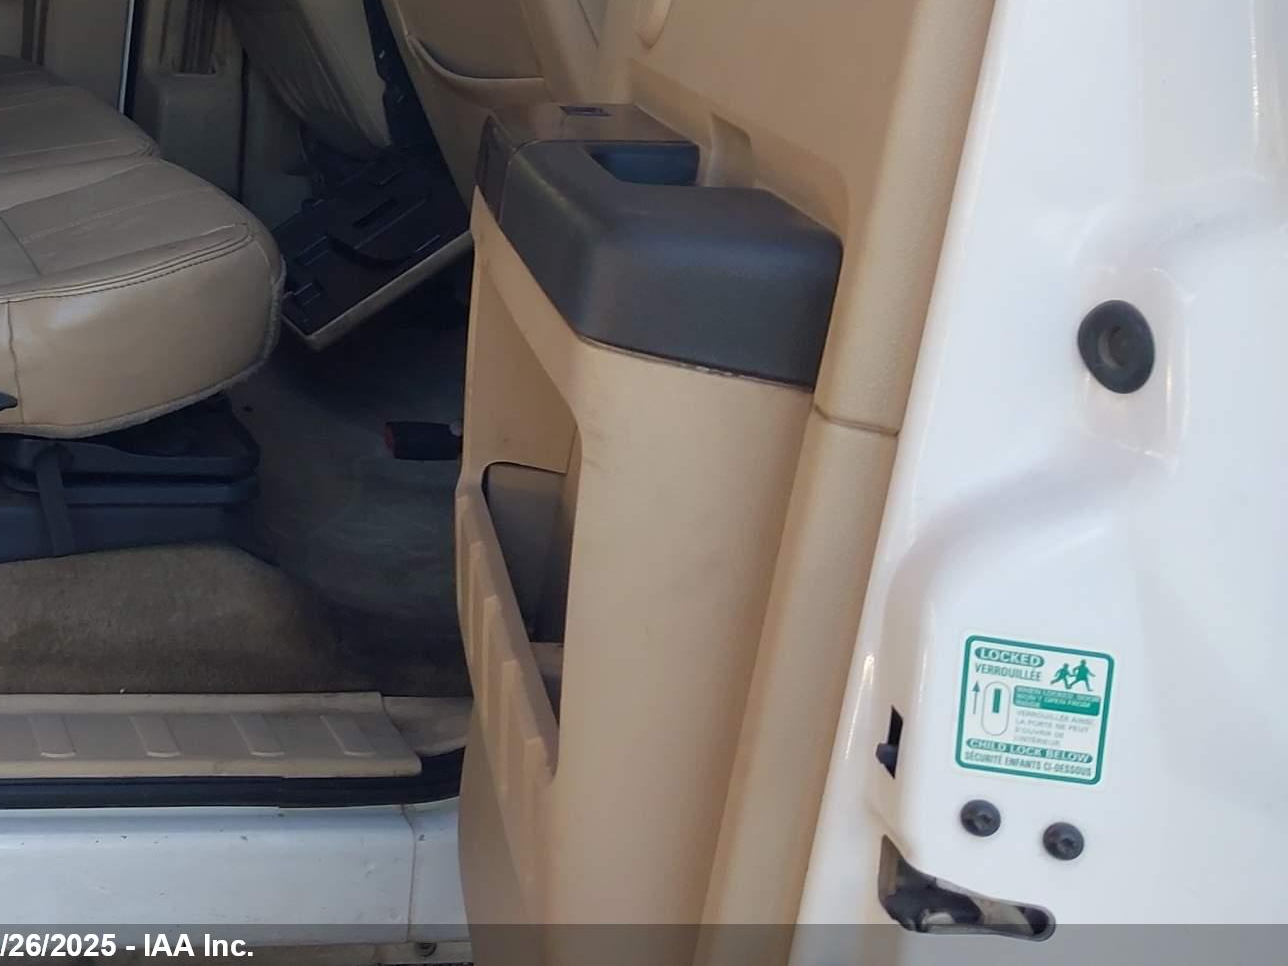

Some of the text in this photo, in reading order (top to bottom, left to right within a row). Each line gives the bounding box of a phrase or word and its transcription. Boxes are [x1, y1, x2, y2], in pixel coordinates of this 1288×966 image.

[980, 648, 1041, 666] LOCKED
[1028, 719, 1053, 728] PORTE
[970, 740, 1090, 763] CHILD LOCK BELOW
[1005, 756, 1041, 771] ENFANTS
[1043, 761, 1091, 777] CI-DESSOUS
